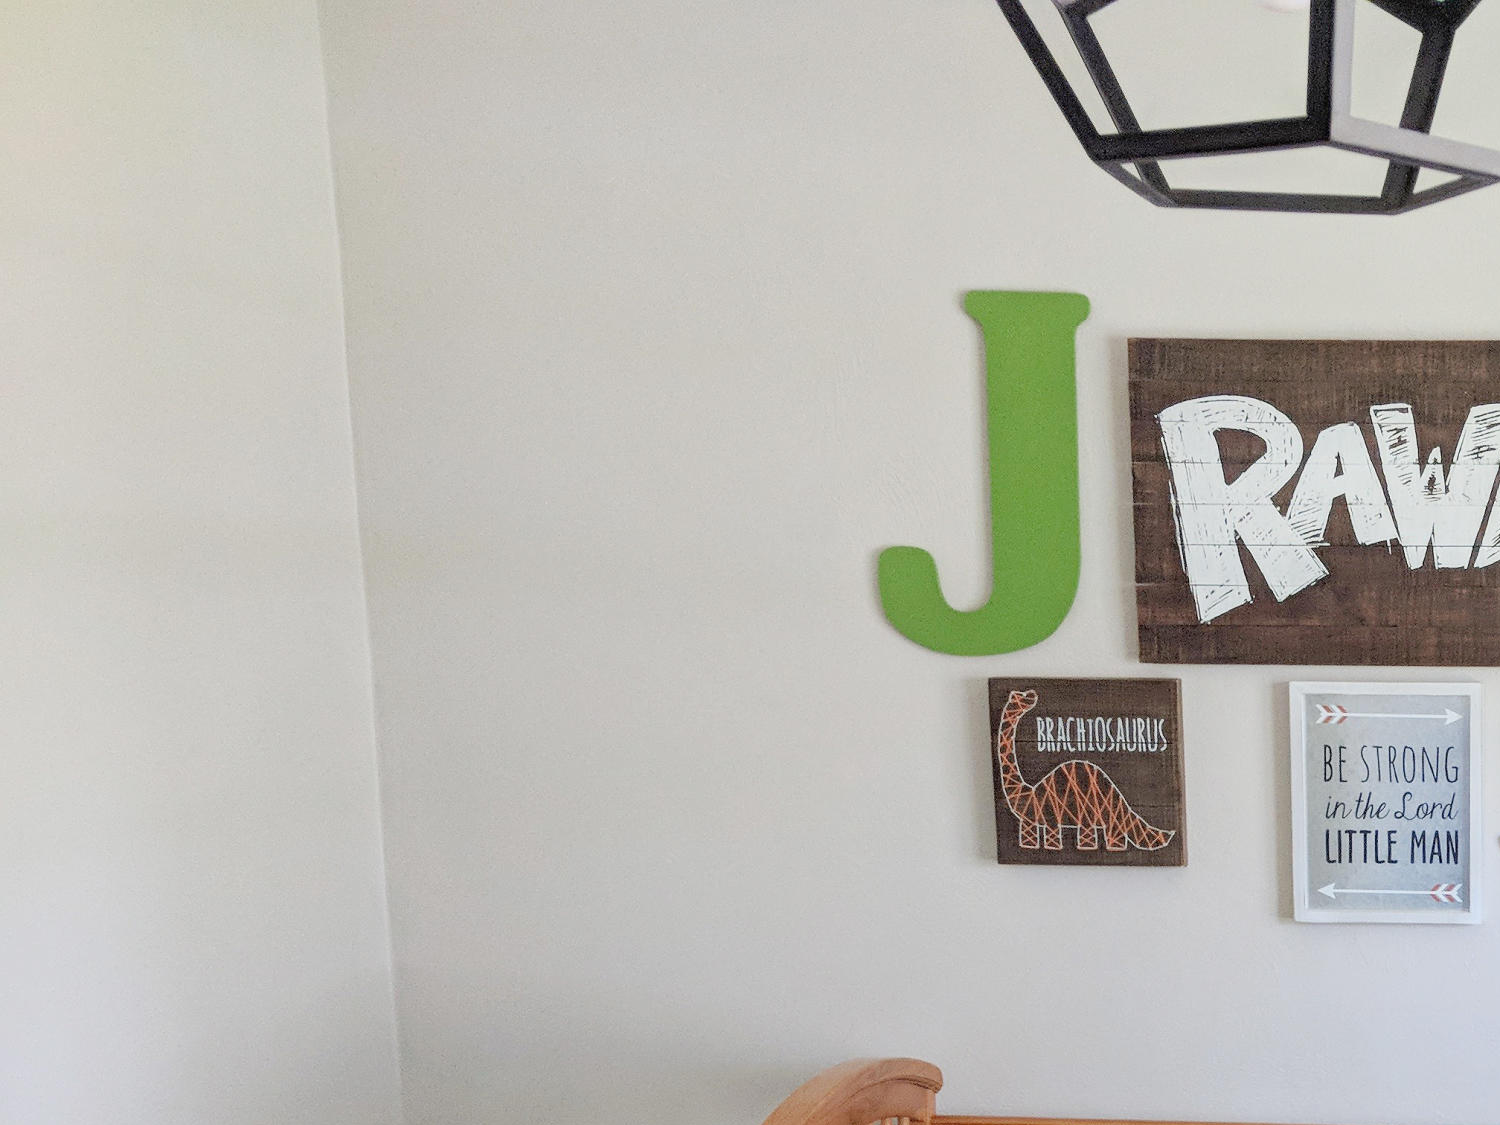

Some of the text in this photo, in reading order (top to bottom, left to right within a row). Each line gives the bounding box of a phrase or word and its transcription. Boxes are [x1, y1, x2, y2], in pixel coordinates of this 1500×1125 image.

[878, 290, 1090, 657] J
[1036, 716, 1168, 752] BRACHIOSAURUS
[1323, 744, 1459, 784] BE STRONG
[1325, 791, 1458, 821] in the Lord
[1325, 829, 1459, 865] LITTLE MAN
